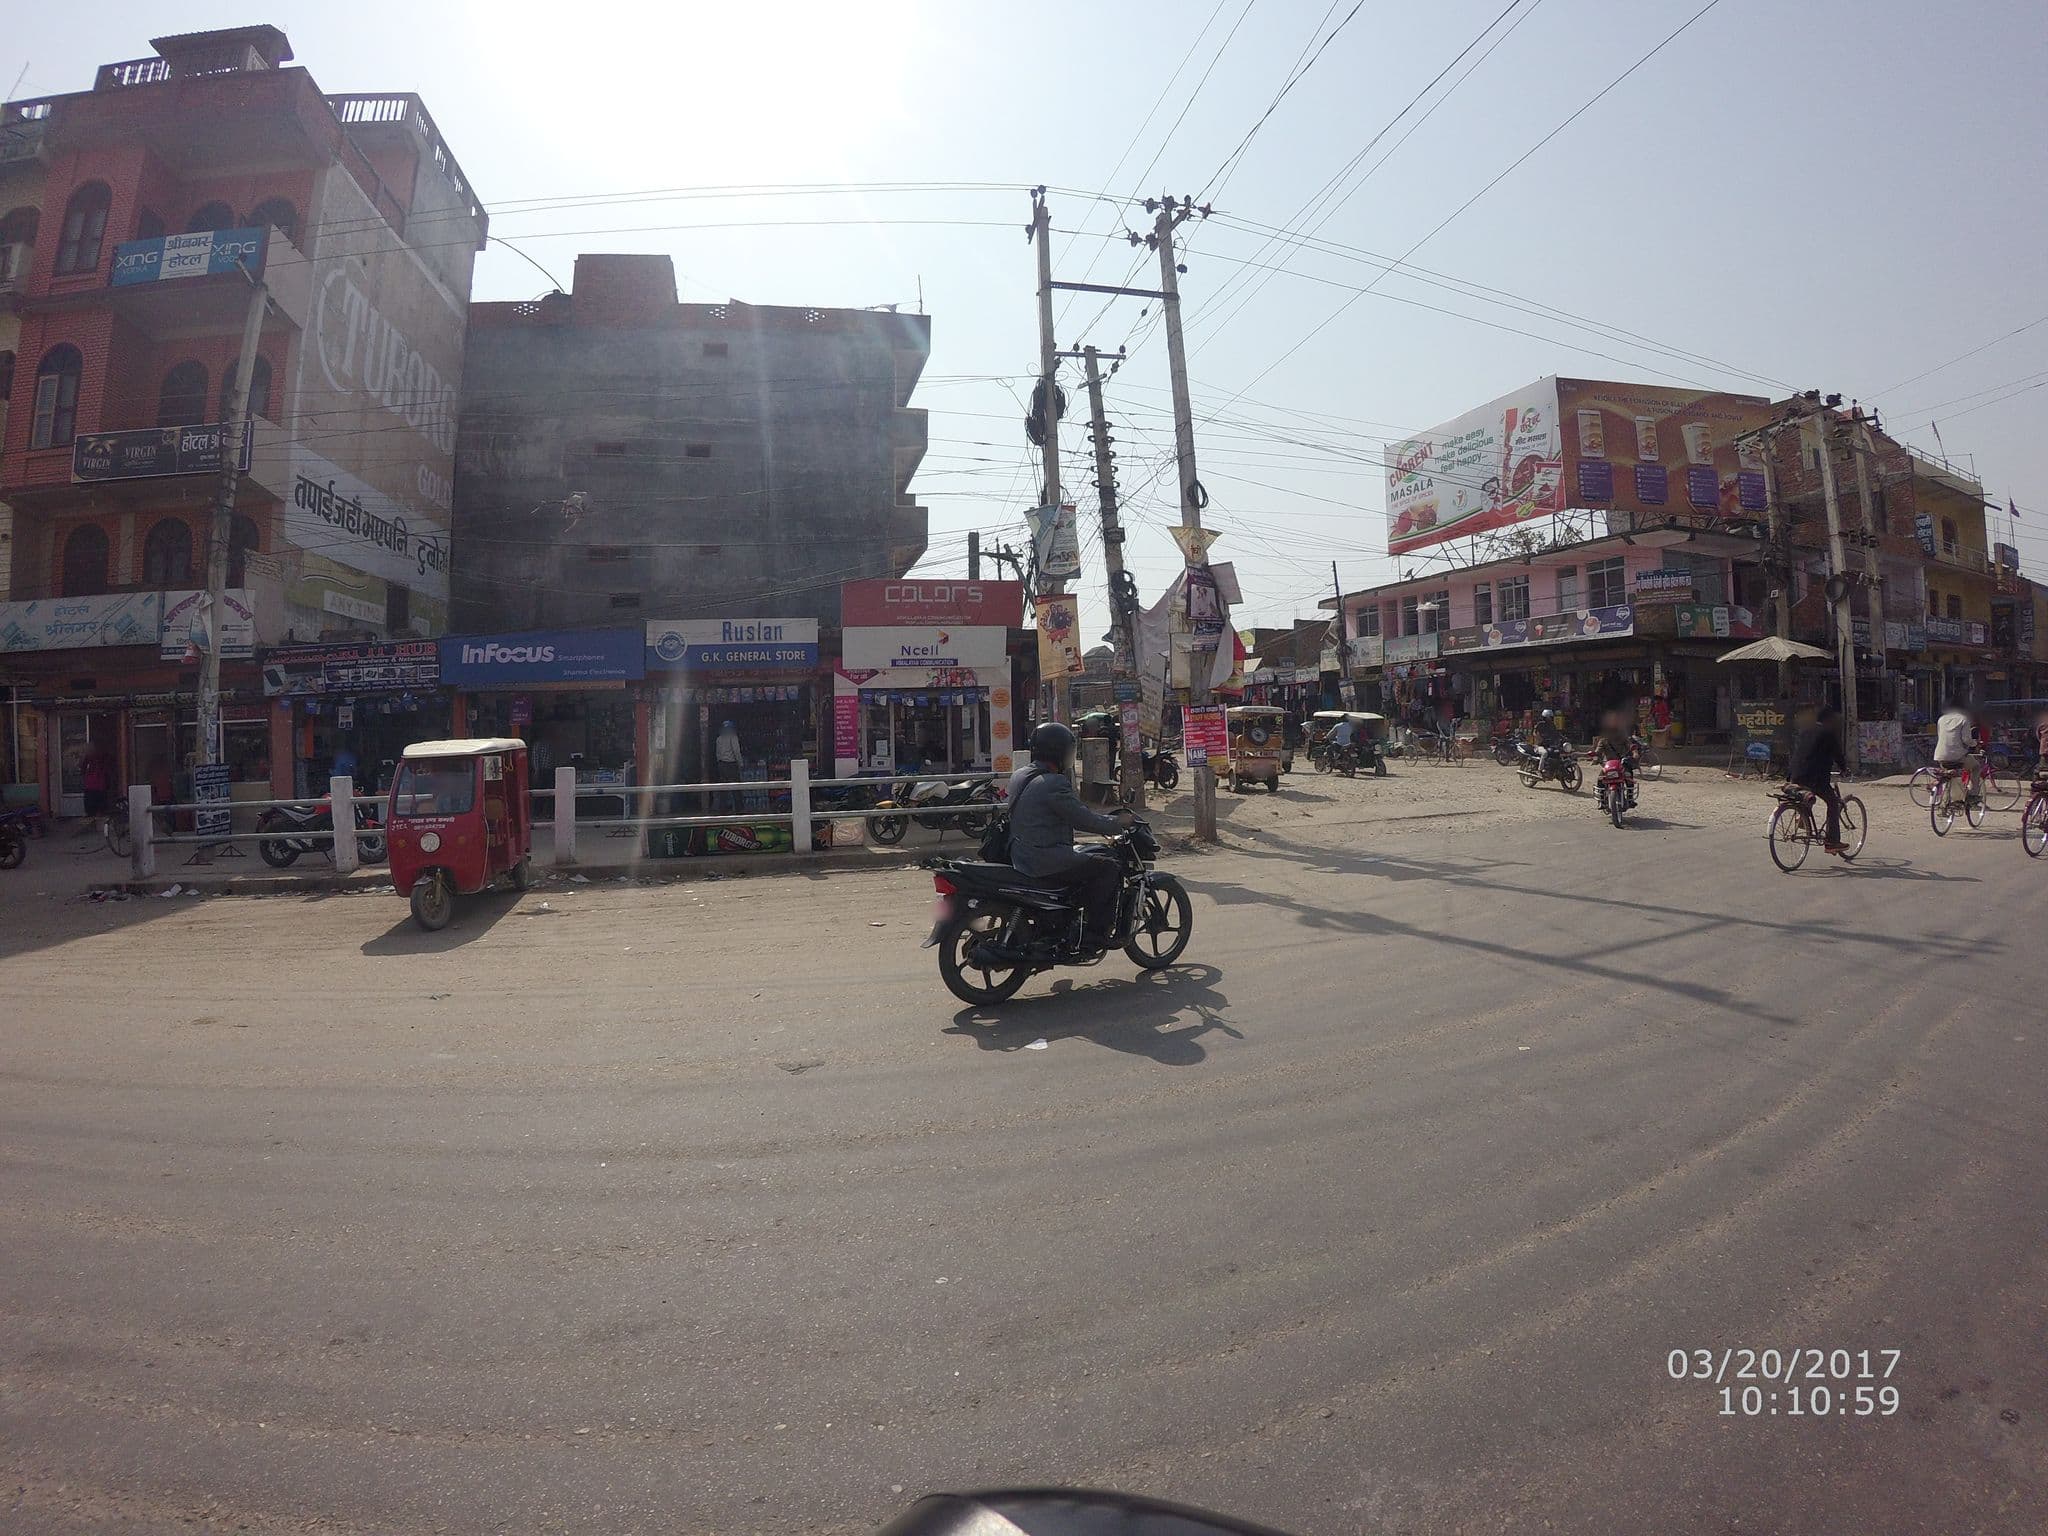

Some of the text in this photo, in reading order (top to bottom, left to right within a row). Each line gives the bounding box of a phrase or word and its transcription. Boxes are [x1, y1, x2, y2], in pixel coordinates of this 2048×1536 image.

[211, 241, 257, 256] XING
[116, 251, 158, 268] XING
[168, 252, 202, 268] होटल
[1441, 427, 1485, 450] make easy
[124, 446, 158, 460] VIRGIN
[1435, 450, 1456, 464] make
[1457, 436, 1494, 456] delicious
[1389, 441, 1434, 488] CURRENT
[1440, 460, 1455, 473] feel
[1390, 478, 1434, 503] MASALA
[722, 621, 783, 642] Ruslan
[394, 642, 438, 656] HUB
[701, 650, 806, 662] G.K. GENERAL STORE
[901, 644, 939, 656] Ncell
[719, 828, 753, 849] TUBORG
